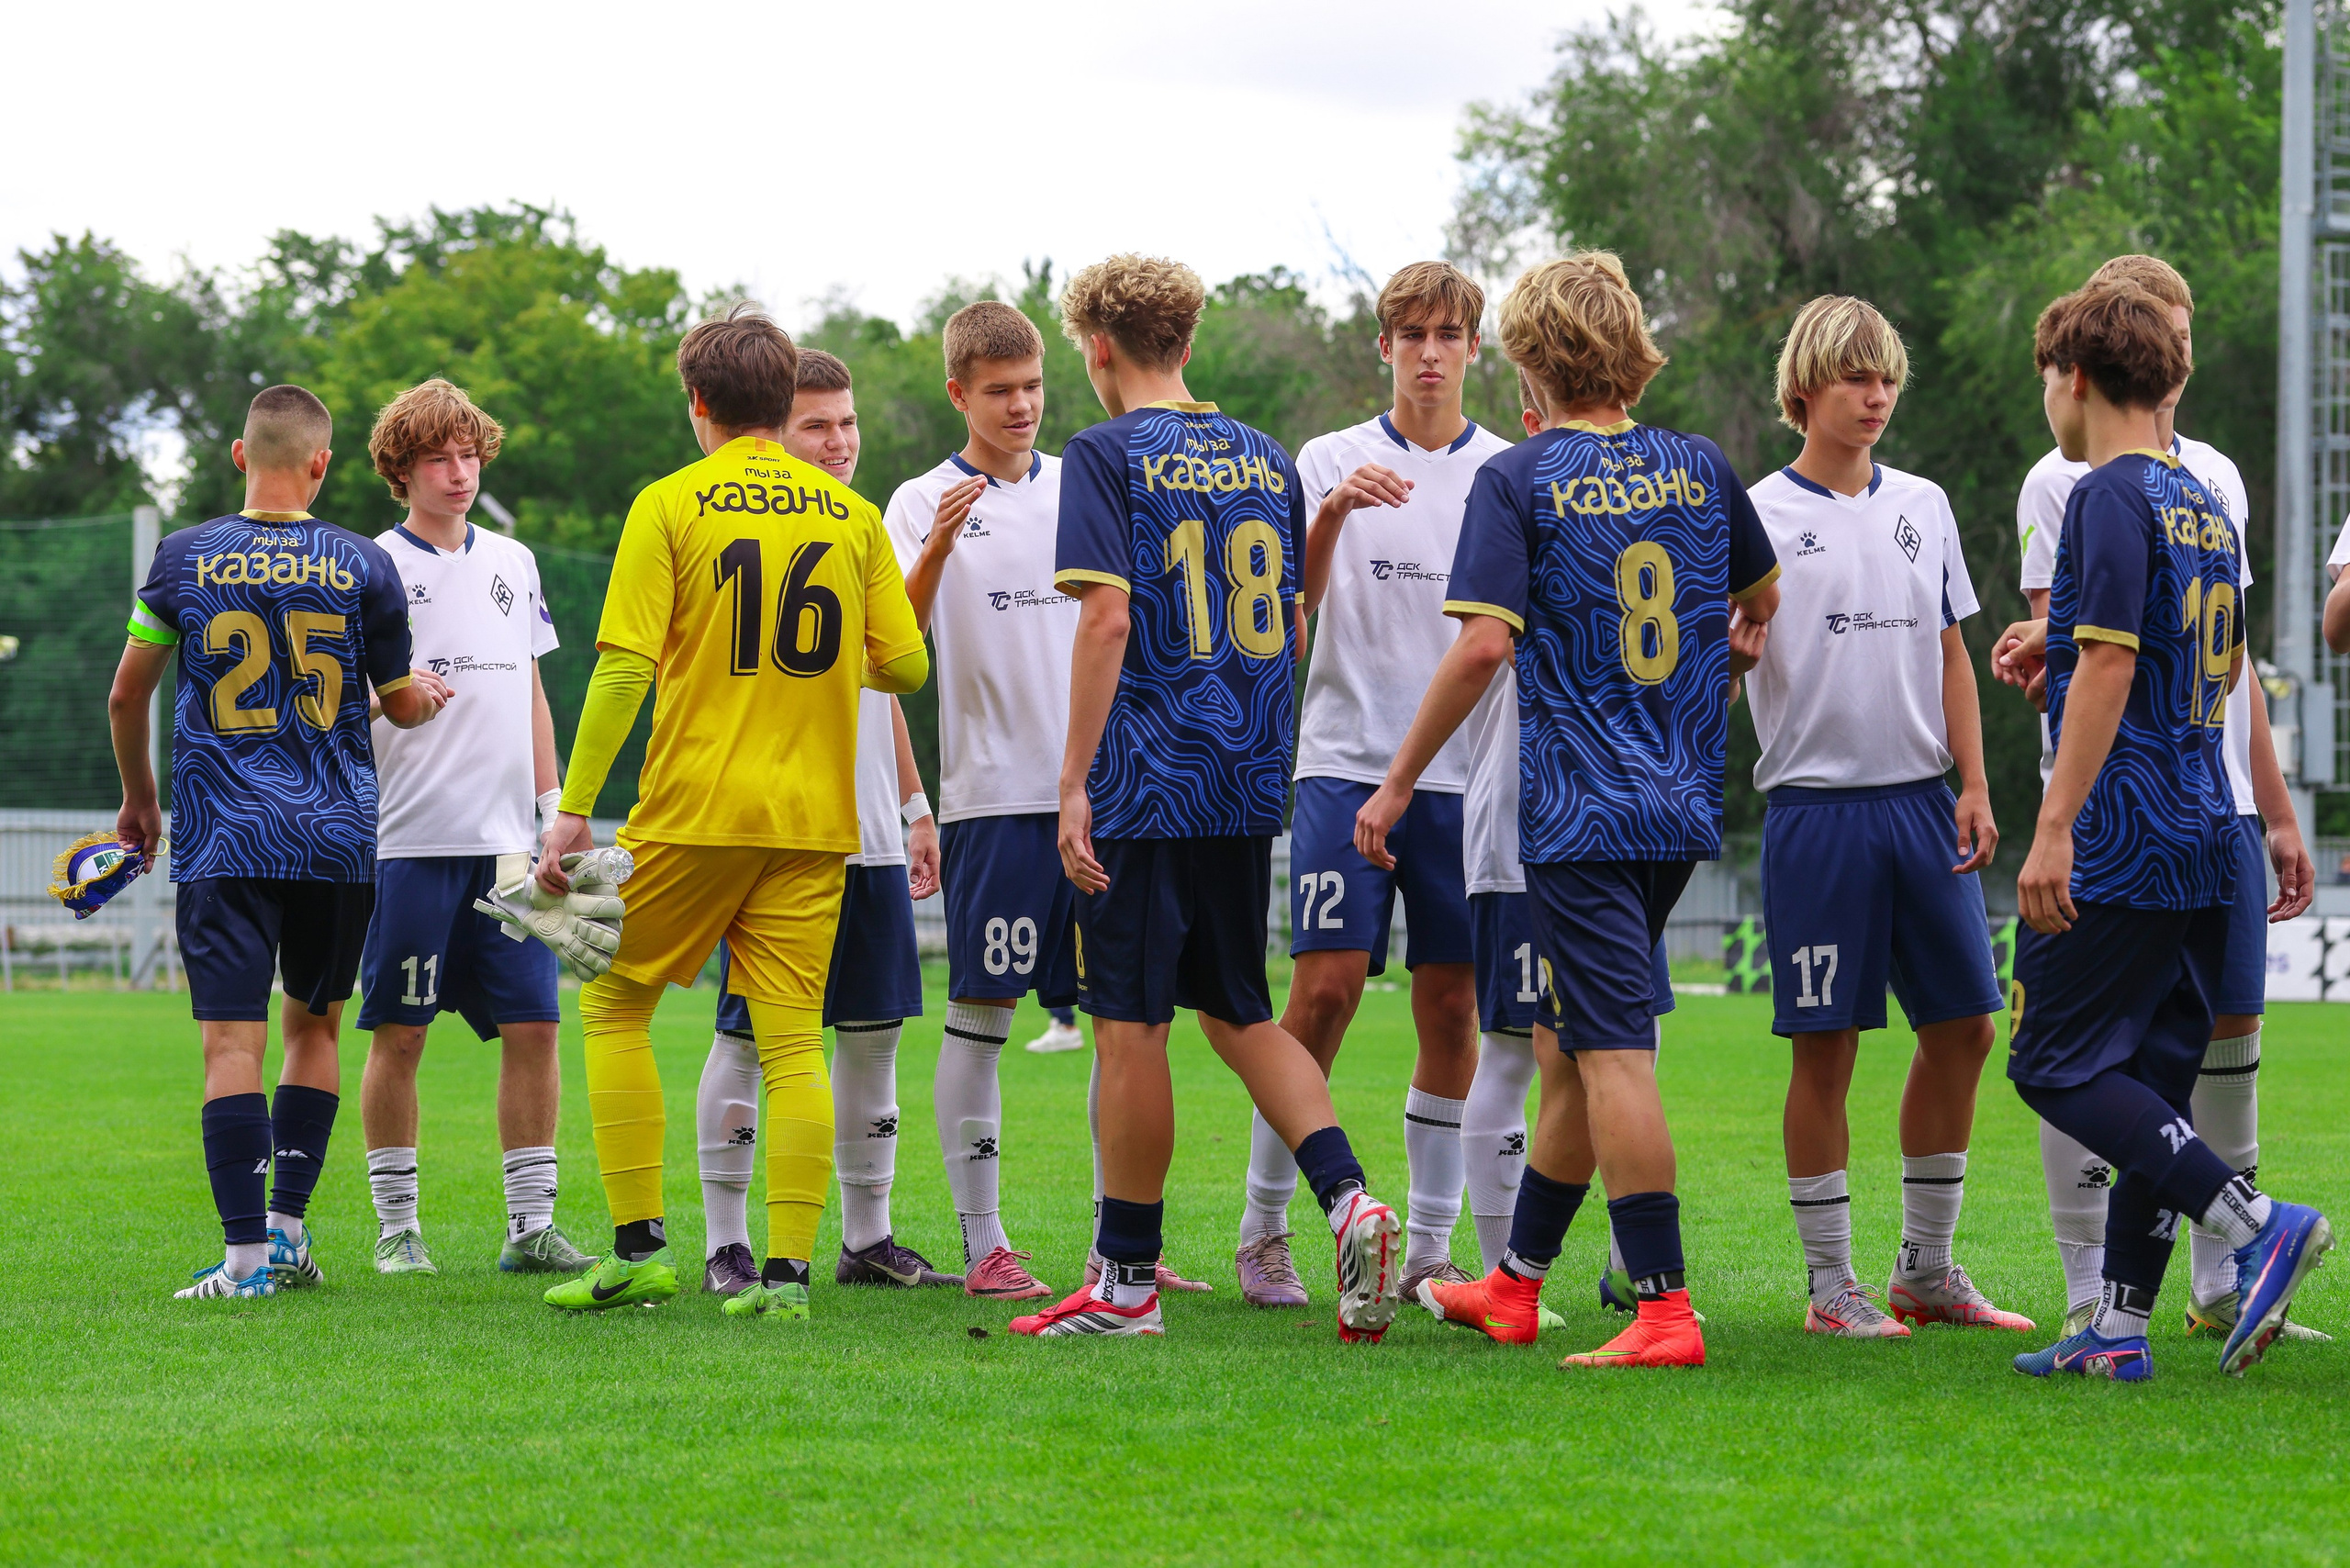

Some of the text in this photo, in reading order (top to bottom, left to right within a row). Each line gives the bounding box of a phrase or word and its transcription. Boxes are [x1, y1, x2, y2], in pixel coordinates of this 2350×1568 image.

[963, 531, 990, 539] KELME
[1796, 546, 1826, 556] KELME
[1014, 589, 1035, 599] ДСК
[1163, 520, 1285, 660] 18
[1396, 572, 1450, 582] ТРАНССТ
[713, 538, 843, 678] 16
[1614, 541, 1679, 686] 8
[1852, 612, 1874, 622] ДСК
[204, 610, 345, 735] 25
[453, 655, 474, 665] ДСК
[2183, 577, 2235, 728] 19
[1299, 870, 1345, 931] 72
[984, 916, 1037, 976] 89
[400, 955, 438, 1006] 11
[1791, 944, 1839, 1008] 17
[1498, 1147, 1525, 1156] KELM
[2094, 1278, 2111, 1331] PEDESIGN
